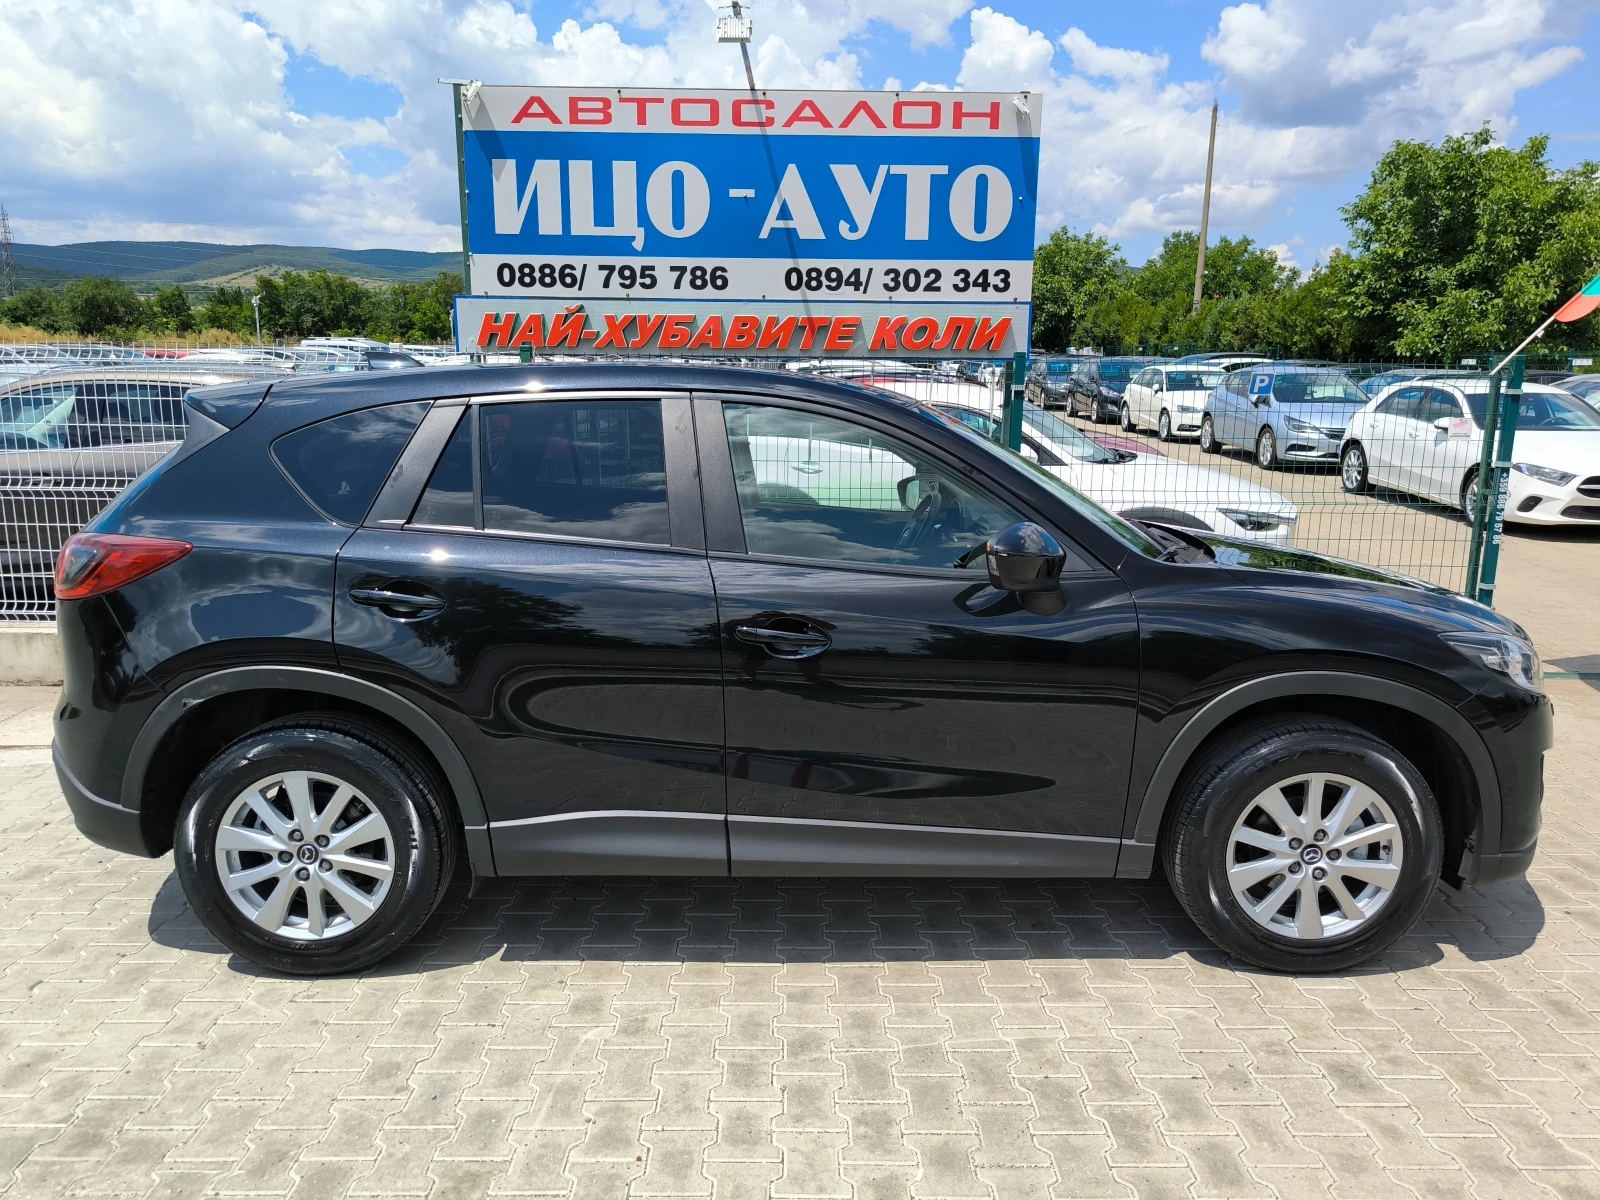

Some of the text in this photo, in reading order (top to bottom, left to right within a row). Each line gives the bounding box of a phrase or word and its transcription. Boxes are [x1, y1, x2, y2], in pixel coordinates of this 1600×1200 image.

[511, 95, 1001, 131] АВТОСАЛОН
[496, 262, 729, 291] 0886/ 795 786
[784, 266, 1011, 295] 0894/ 302 343
[476, 303, 1013, 352] НАЙ-ХУБАВИТЕ КОЛИ
[1253, 375, 1270, 393] P
[1496, 494, 1506, 508] 886
[1495, 511, 1504, 520] 79
[1493, 523, 1502, 532] 57
[1492, 534, 1501, 544] 86
